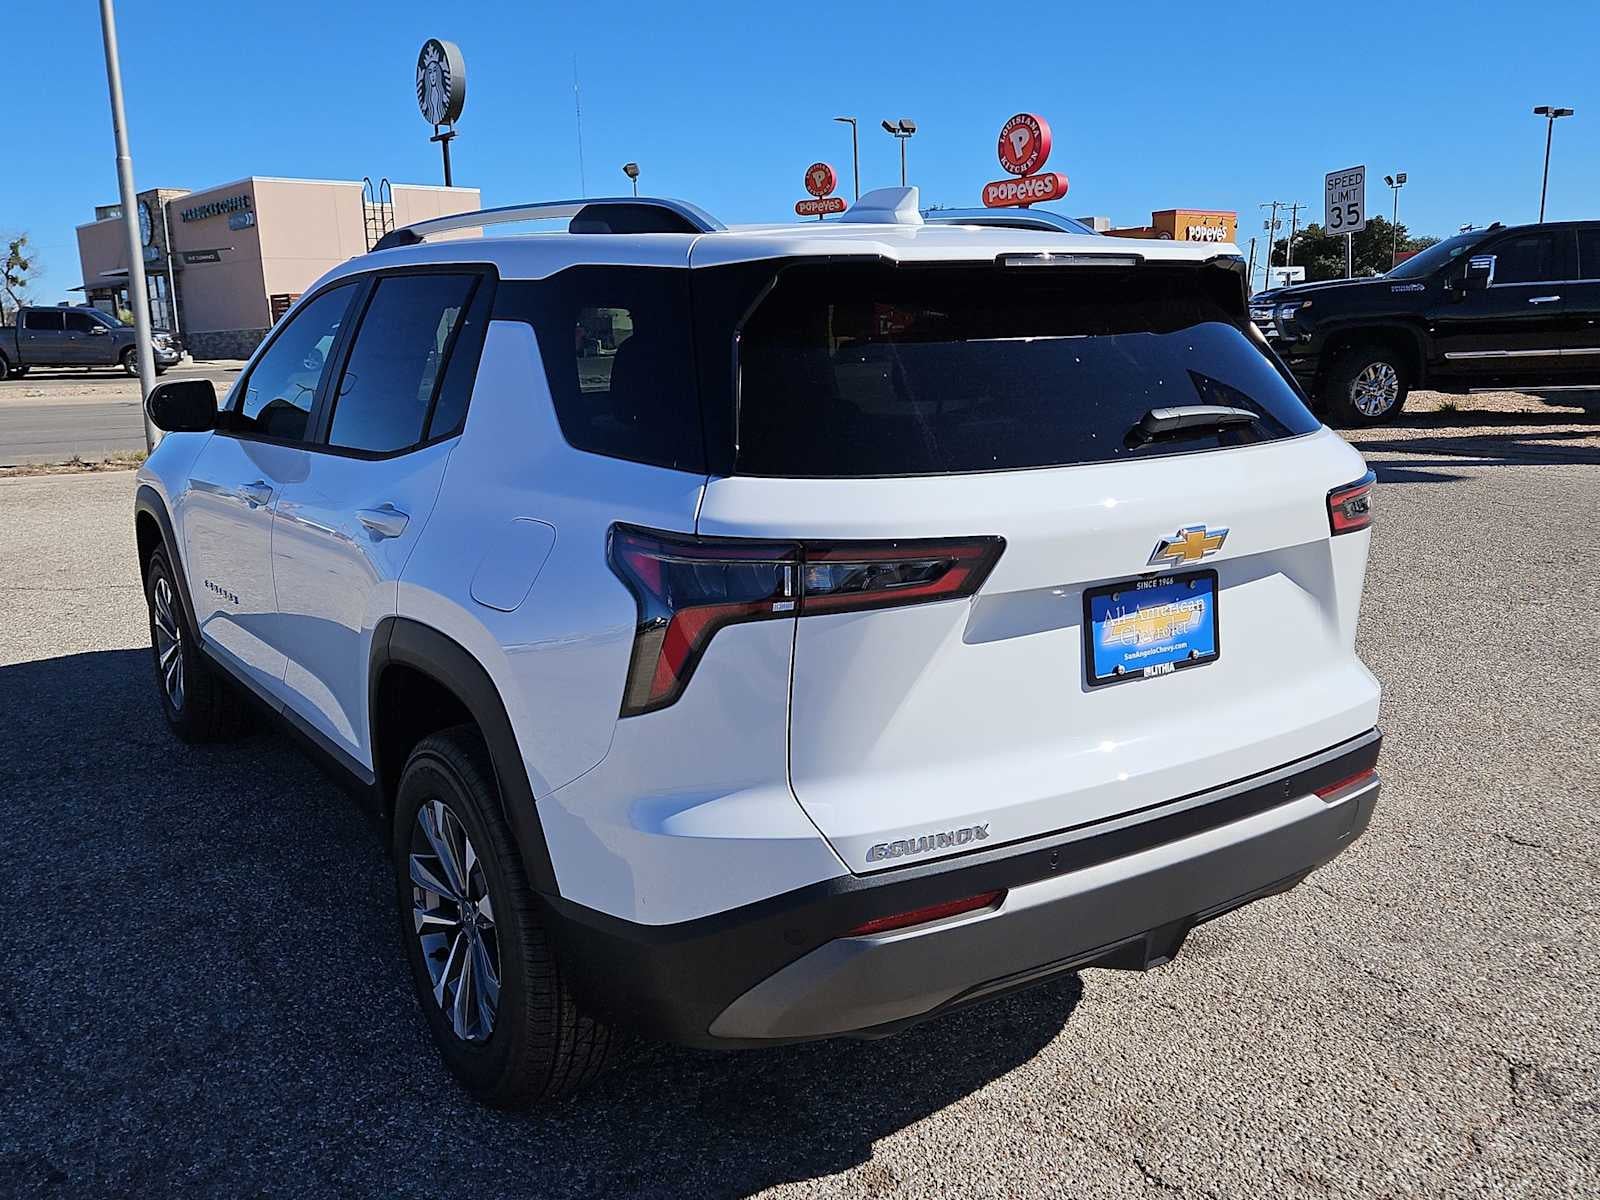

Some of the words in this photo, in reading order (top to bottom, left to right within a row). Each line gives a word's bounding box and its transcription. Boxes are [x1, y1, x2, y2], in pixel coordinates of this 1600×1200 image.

[1000, 115, 1040, 143] LOUISIANA
[1009, 128, 1030, 159] P
[1000, 151, 1039, 173] KITCHEN
[812, 170, 826, 188] P
[1327, 173, 1363, 191] SPEED
[1331, 188, 1358, 205] LIMIT
[1330, 202, 1360, 229] 35
[1136, 579, 1158, 591] SINCE
[1102, 605, 1127, 629] All
[1134, 597, 1206, 621] American
[1120, 616, 1190, 646] Chevrolet
[1124, 642, 1189, 661] SanAngeloChevy.com
[1151, 662, 1176, 677] LITHIA
[865, 822, 991, 863] EQUINOX
